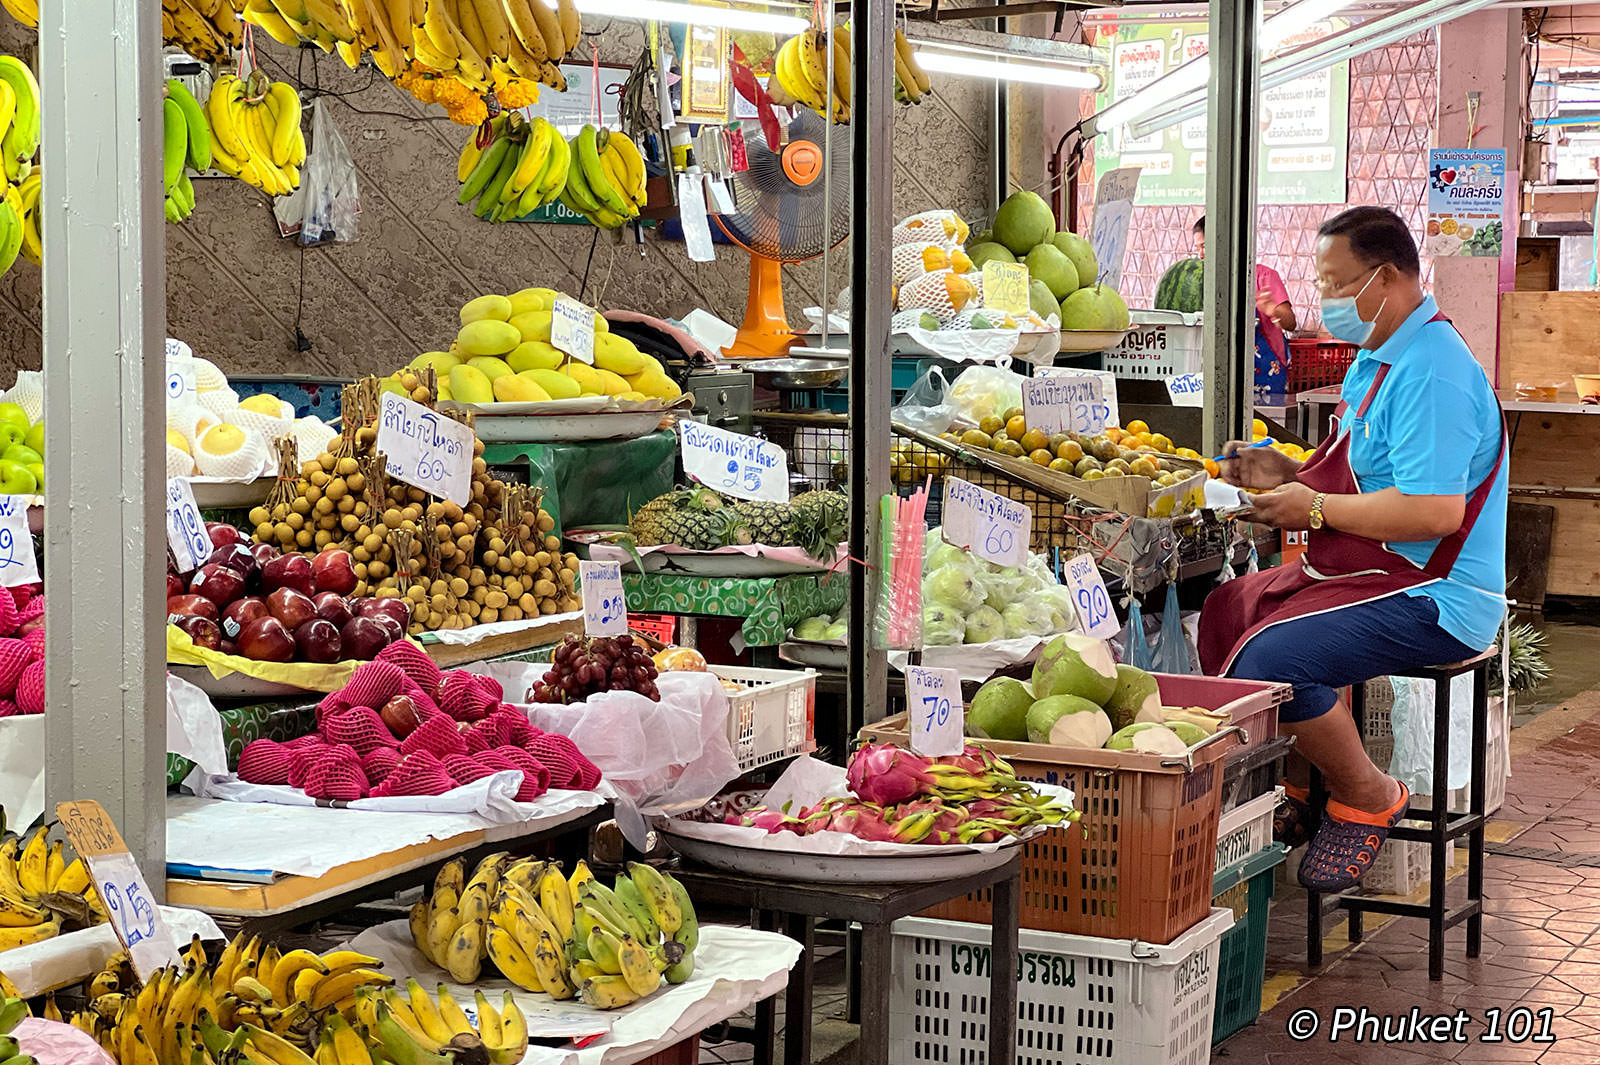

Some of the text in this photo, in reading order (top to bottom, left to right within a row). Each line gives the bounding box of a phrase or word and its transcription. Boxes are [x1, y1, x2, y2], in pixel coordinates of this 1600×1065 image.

[1168, 27, 1184, 66] 2
[1433, 150, 1503, 161] ร้านนี้เข้าร่วมโครงการ
[1449, 180, 1502, 199] คนละครึ่ง
[1105, 350, 1161, 360] ามซื้อขาย
[1075, 404, 1103, 433] 35
[985, 523, 1013, 554] 60
[1078, 584, 1108, 629] 20
[104, 881, 155, 948] 25
